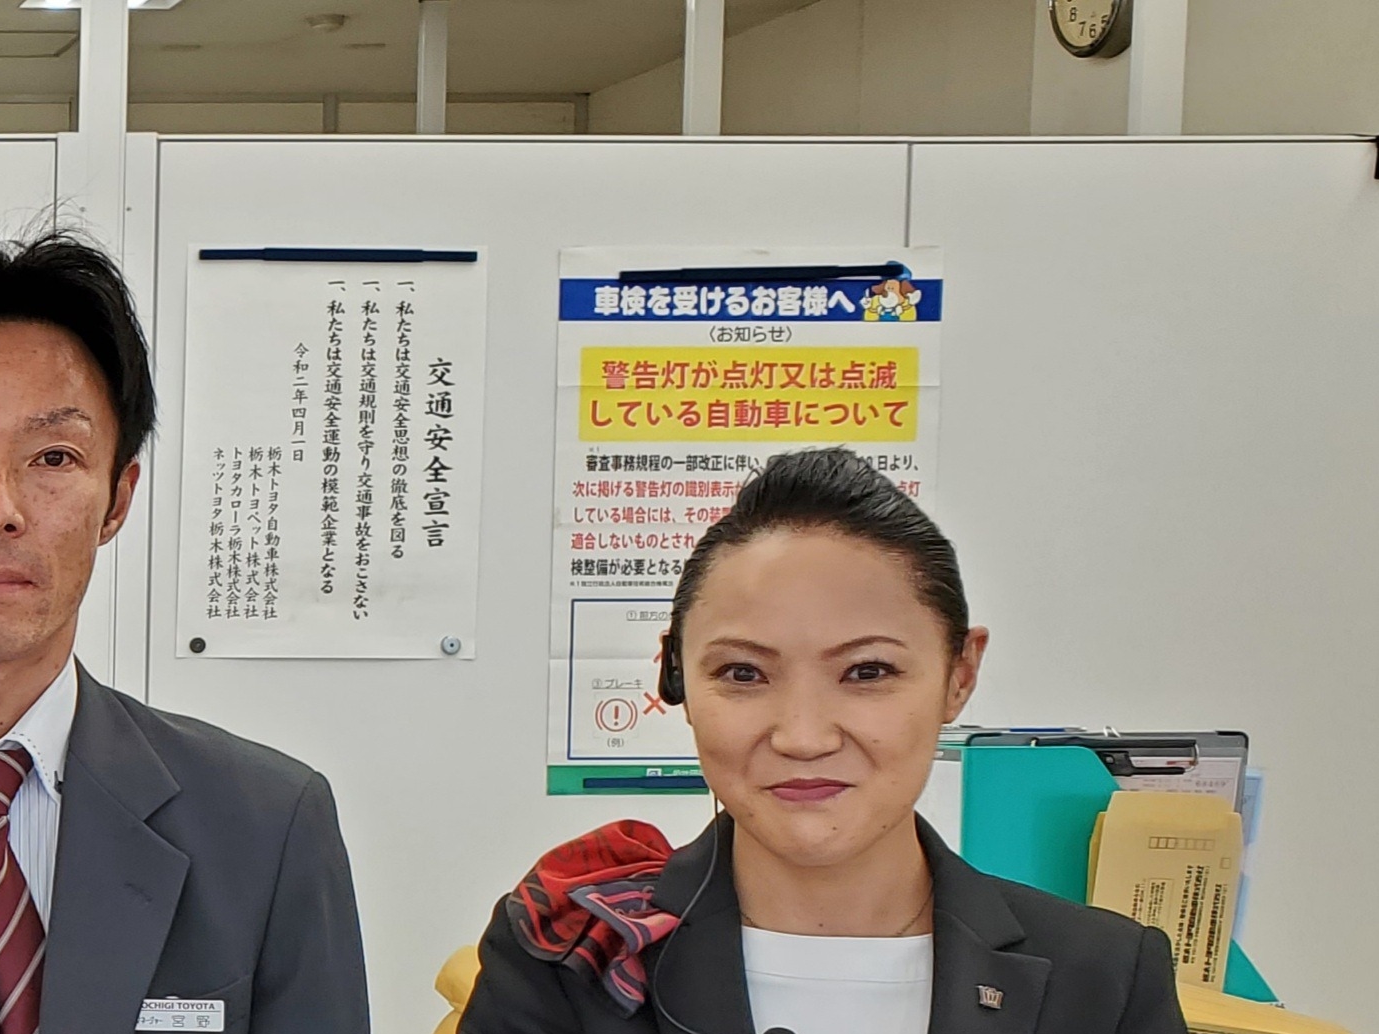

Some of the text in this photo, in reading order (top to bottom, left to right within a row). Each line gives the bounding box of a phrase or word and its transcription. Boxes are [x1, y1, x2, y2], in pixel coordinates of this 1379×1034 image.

[594, 285, 856, 317] 車検を受けるお客様へ
[602, 360, 897, 390] 警告灯が点灯又は点滅
[291, 342, 309, 462] 令和二年四月一日
[320, 281, 346, 594] 一、私たちは交通安全運動の模範企業となる
[353, 281, 380, 620] 一、私たちは交通規則を守り交通事故をおこさない
[390, 281, 415, 559] 一、私たちは交通安全思想の徹底を図る
[422, 357, 455, 547] 交通安全宣言
[591, 400, 909, 429] している自動車について
[206, 447, 226, 619] ネッツトヨタ栃木株式会社
[225, 447, 243, 619] トヨタカローラ栃木株式会社
[243, 446, 263, 619] 栃木トヨペット株式会社
[262, 446, 282, 620] 栃木トヨタ自動車株式会社
[177, 1002, 215, 1010] TOYOTA
